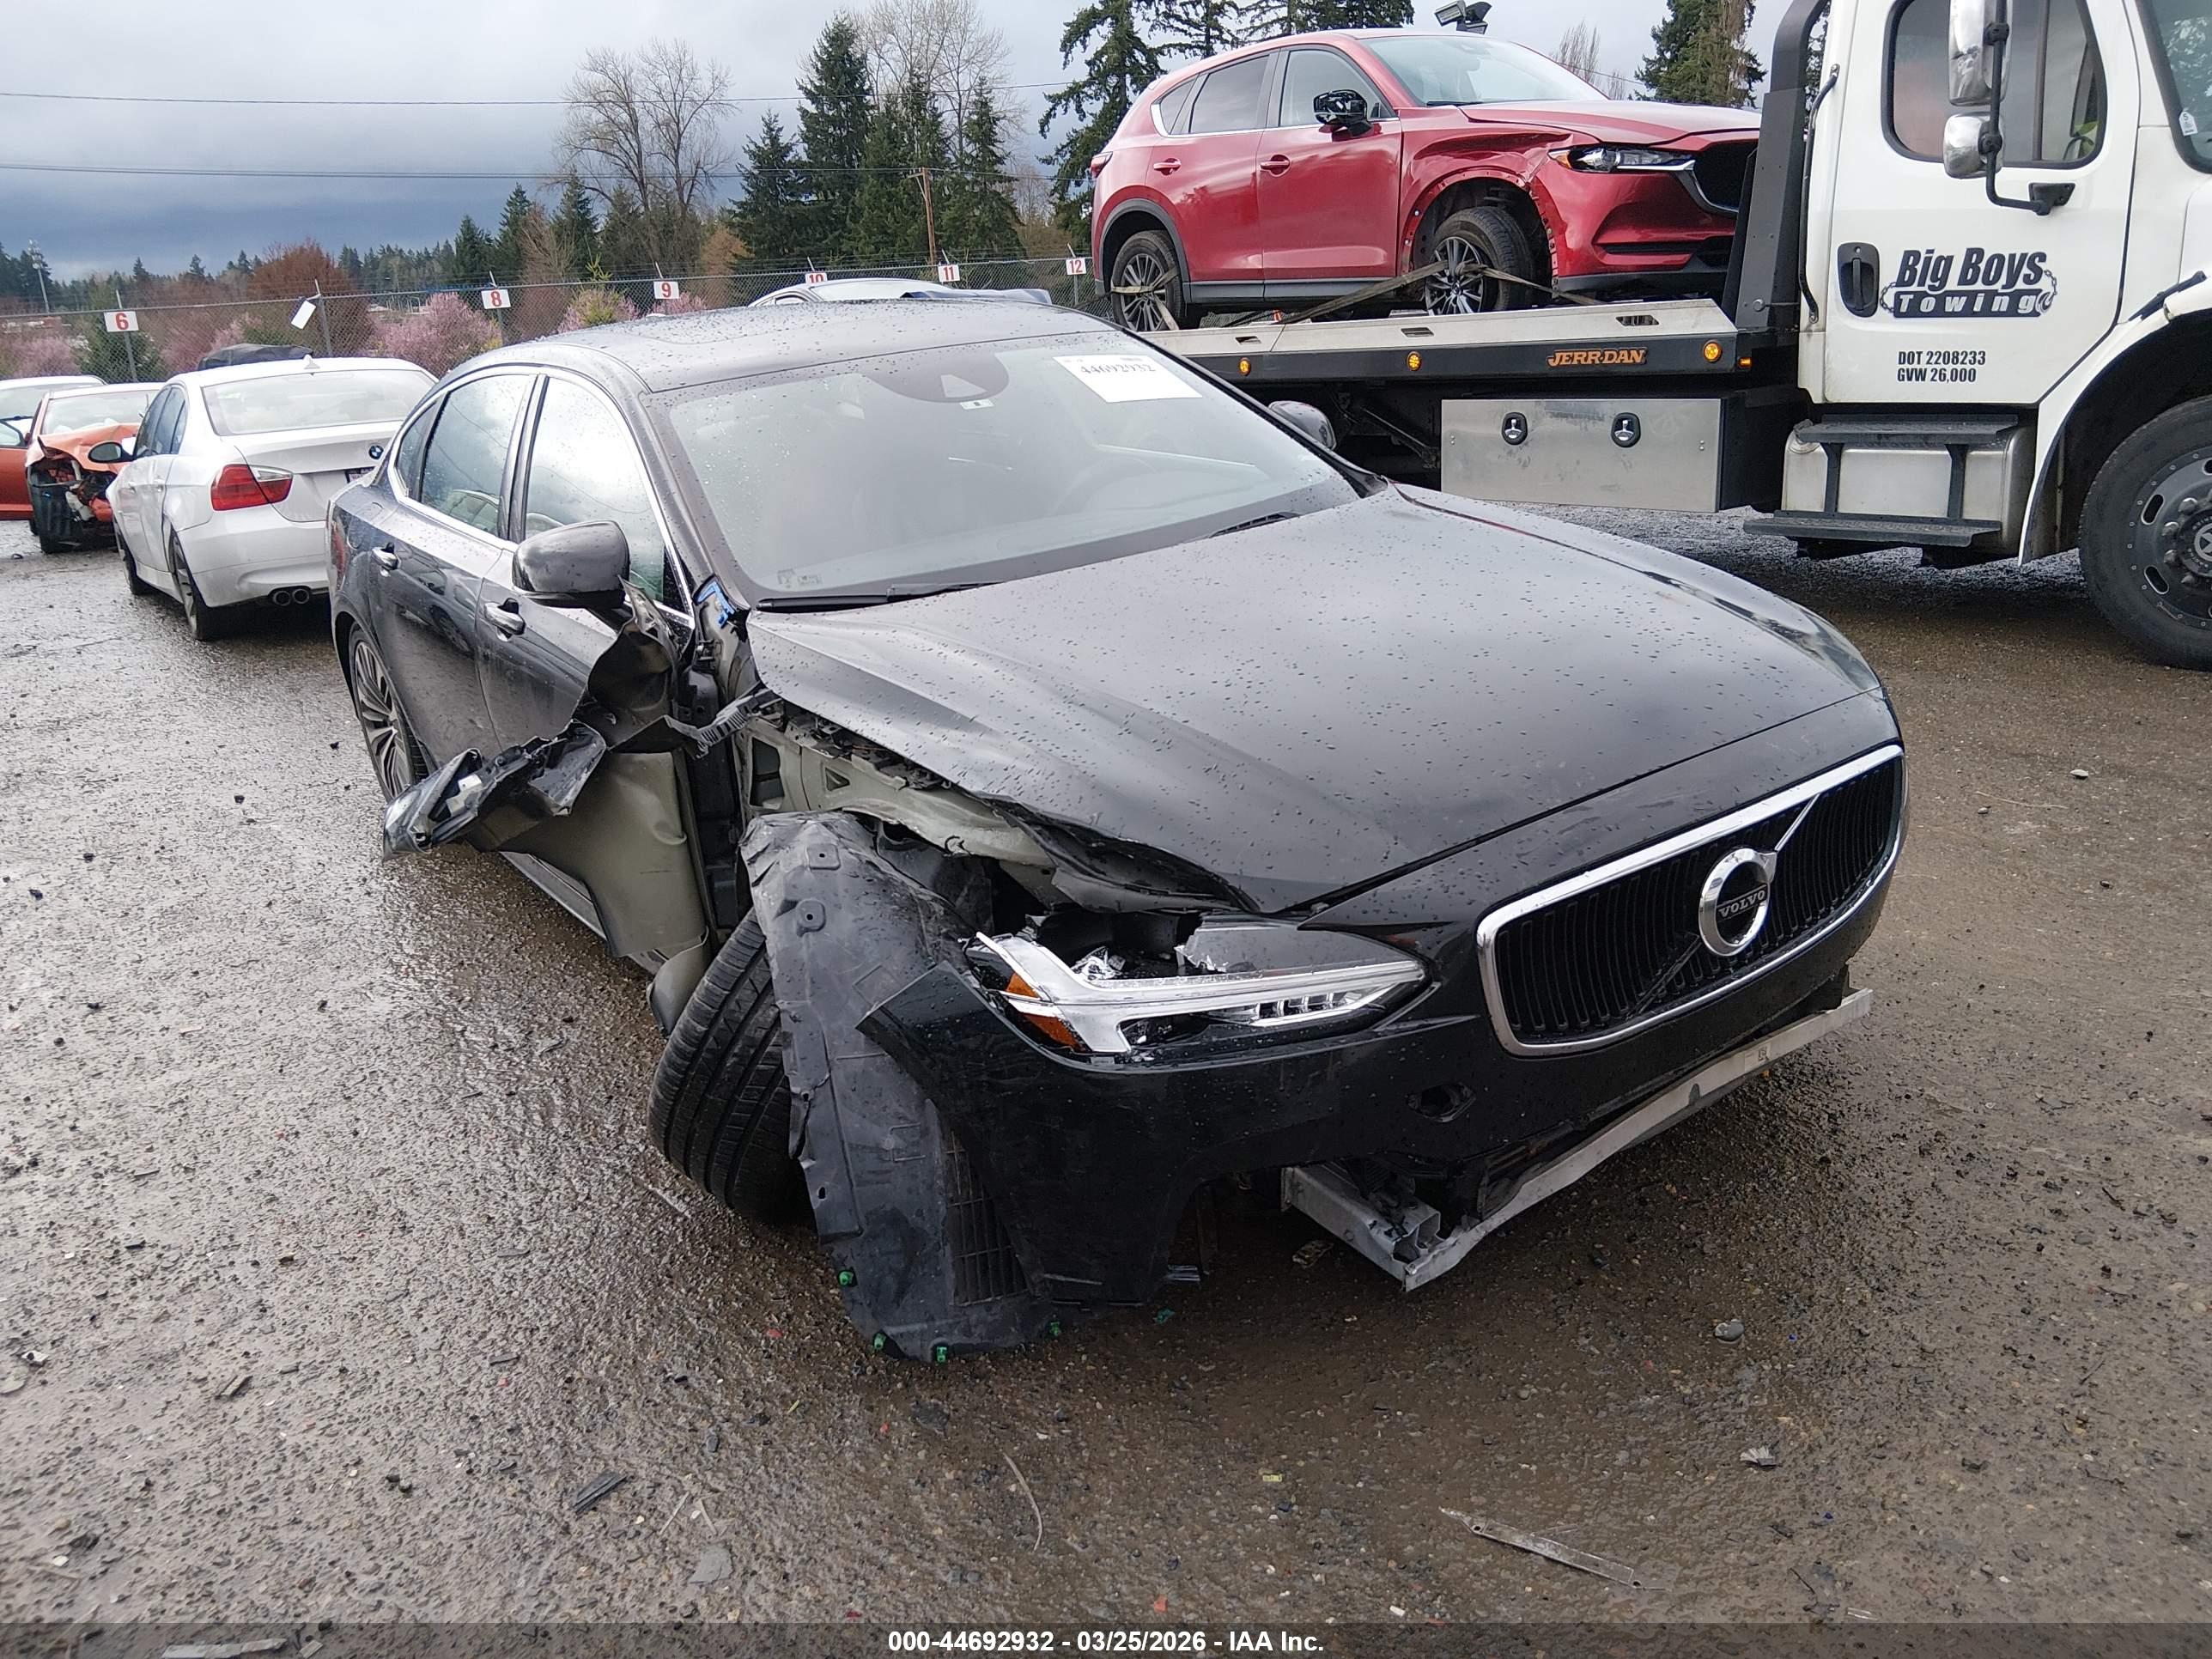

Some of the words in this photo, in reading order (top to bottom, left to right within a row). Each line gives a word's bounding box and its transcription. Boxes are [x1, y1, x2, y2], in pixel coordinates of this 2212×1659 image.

[944, 266, 954, 281] 11
[1070, 259, 1083, 274] 12
[1896, 249, 1954, 291] Big
[1957, 247, 2047, 289] Boys
[661, 283, 672, 298] 9
[490, 291, 502, 307] 8
[1899, 293, 2037, 313] Towing
[115, 313, 130, 331] 6
[1898, 350, 1923, 365] DOT
[1926, 350, 1986, 365] 2208233
[1897, 368, 1927, 382] GVW
[1929, 368, 1977, 383] 26,000
[1718, 890, 1766, 918] VOLVO
